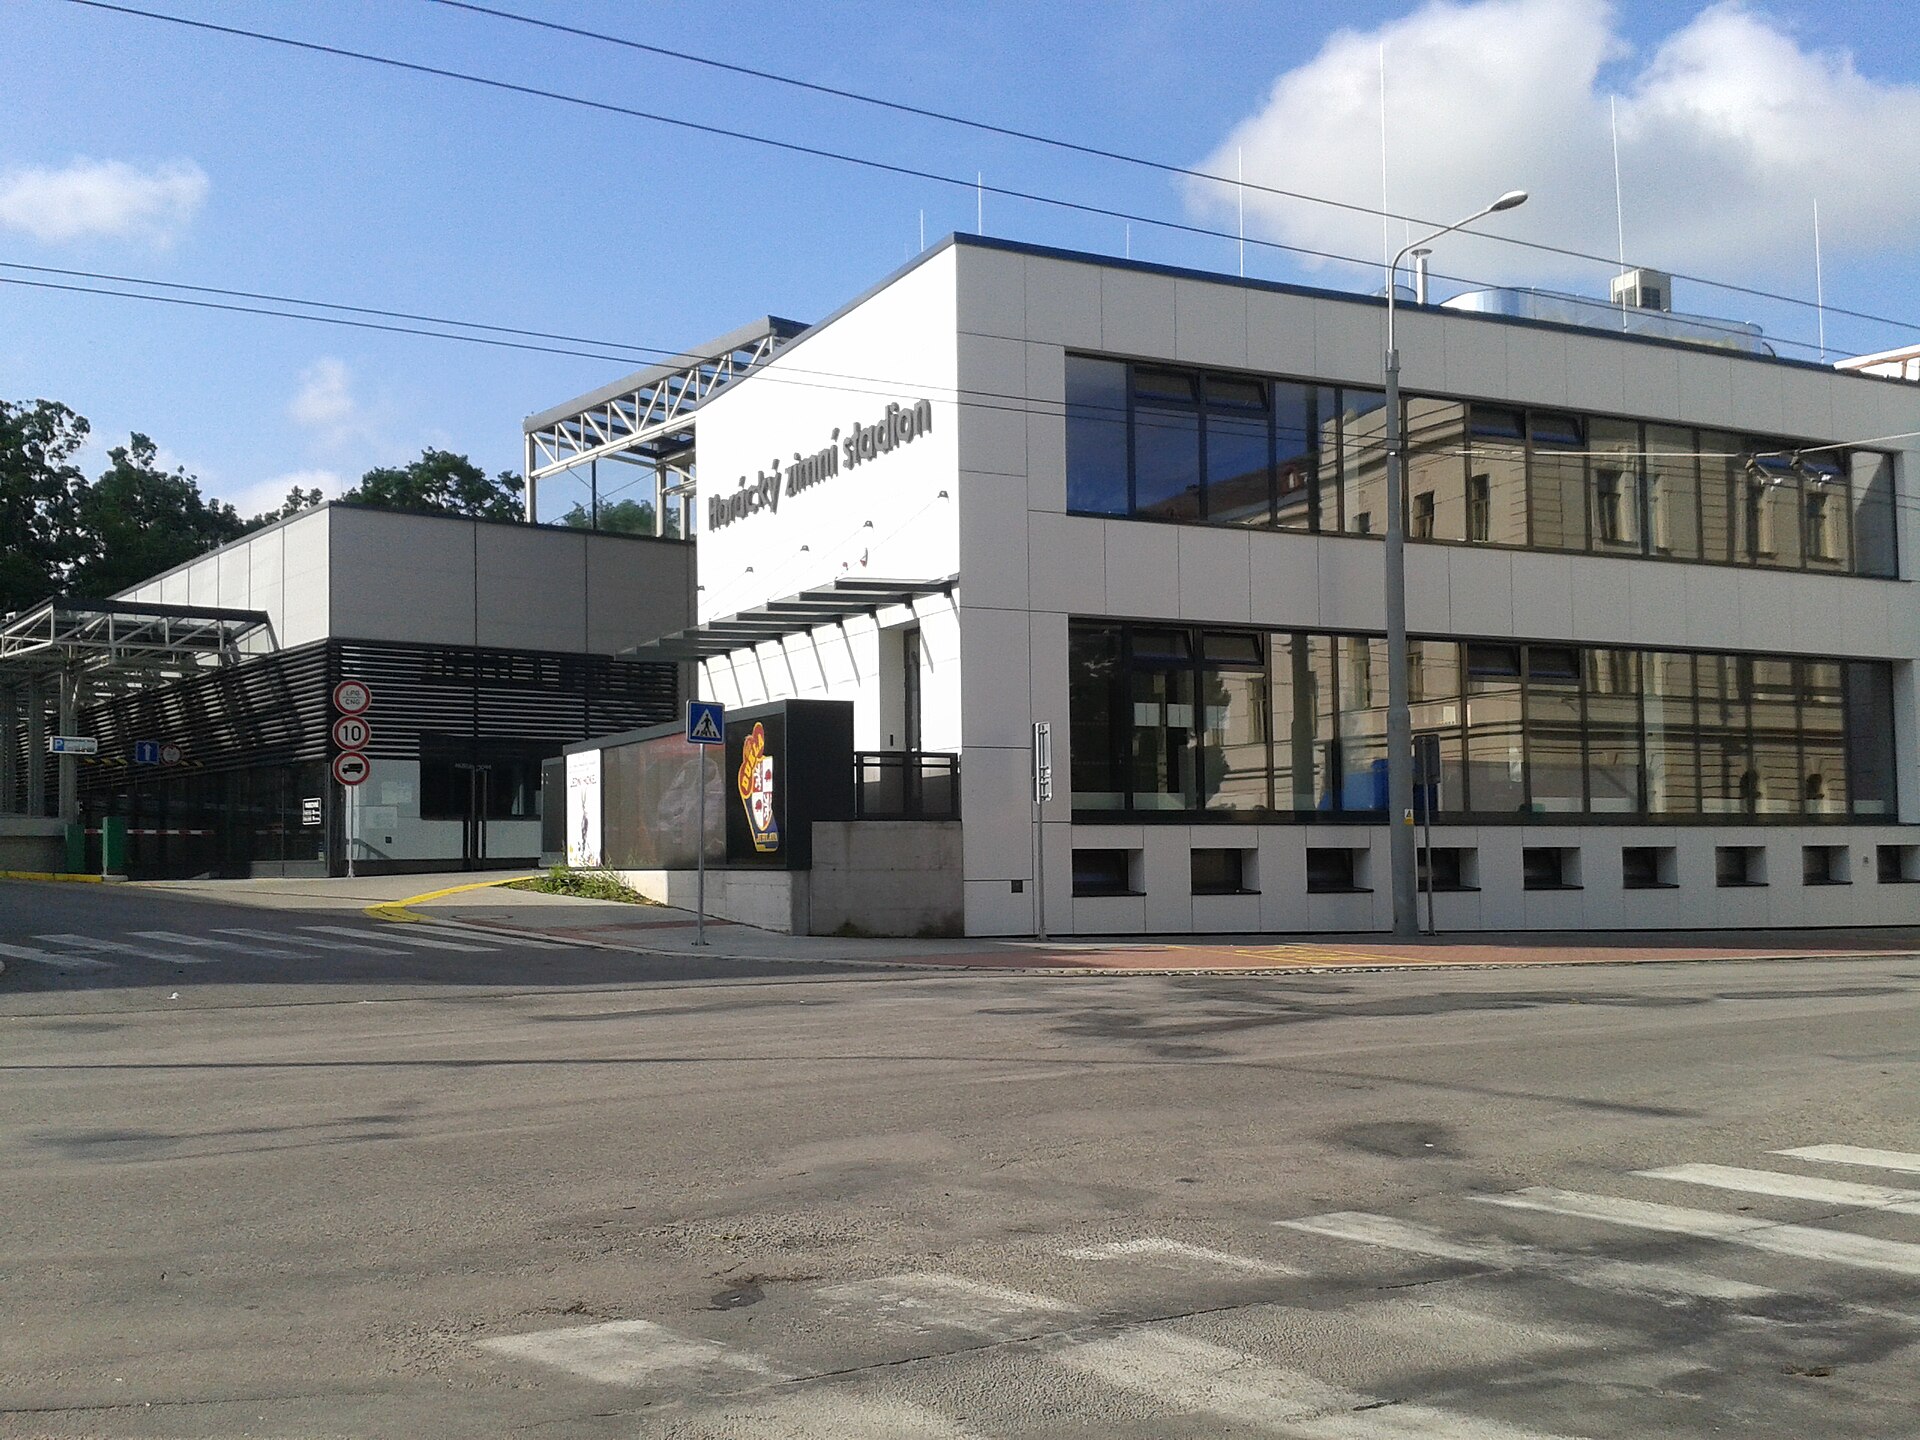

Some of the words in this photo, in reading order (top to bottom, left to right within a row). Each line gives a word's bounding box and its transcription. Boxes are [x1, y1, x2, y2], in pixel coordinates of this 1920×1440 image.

[709, 459, 782, 532] Horácký
[785, 427, 840, 498] zimní
[843, 399, 932, 471] stadion
[342, 725, 362, 742] 10
